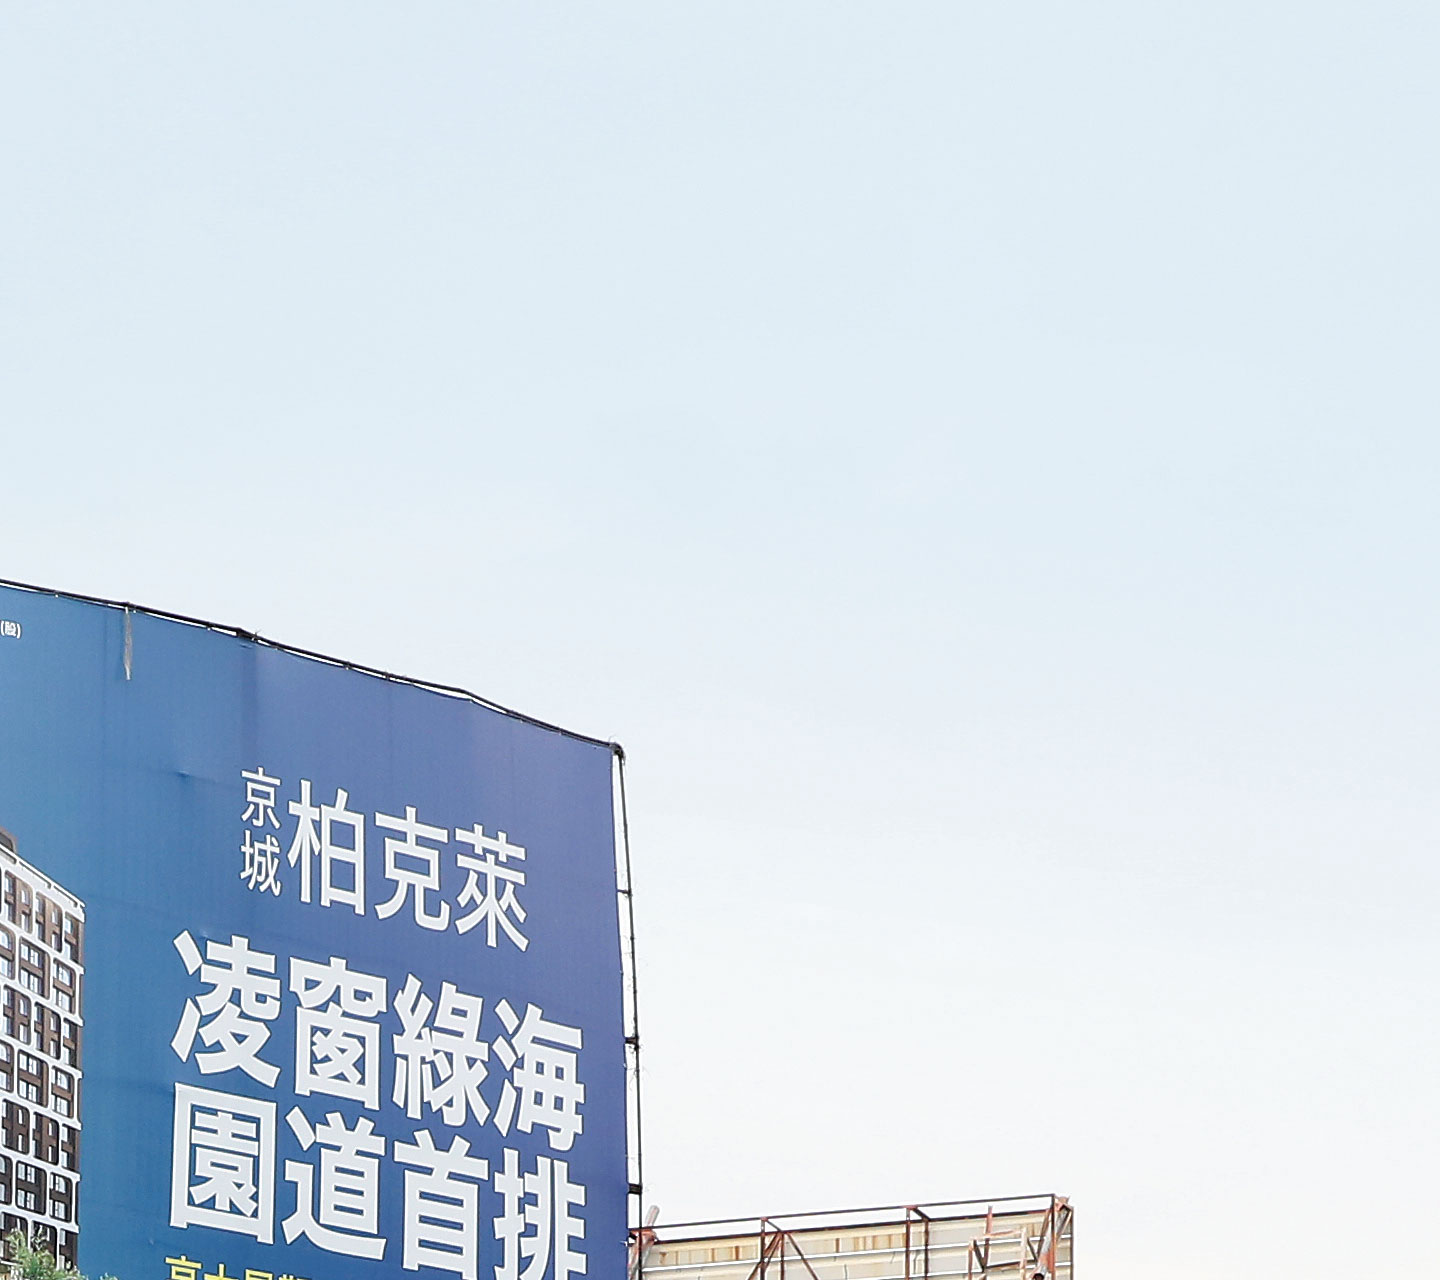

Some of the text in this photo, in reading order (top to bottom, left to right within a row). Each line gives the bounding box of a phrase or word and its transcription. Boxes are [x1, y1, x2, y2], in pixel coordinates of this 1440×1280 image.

[239, 766, 532, 952] 京城 柏克萊
